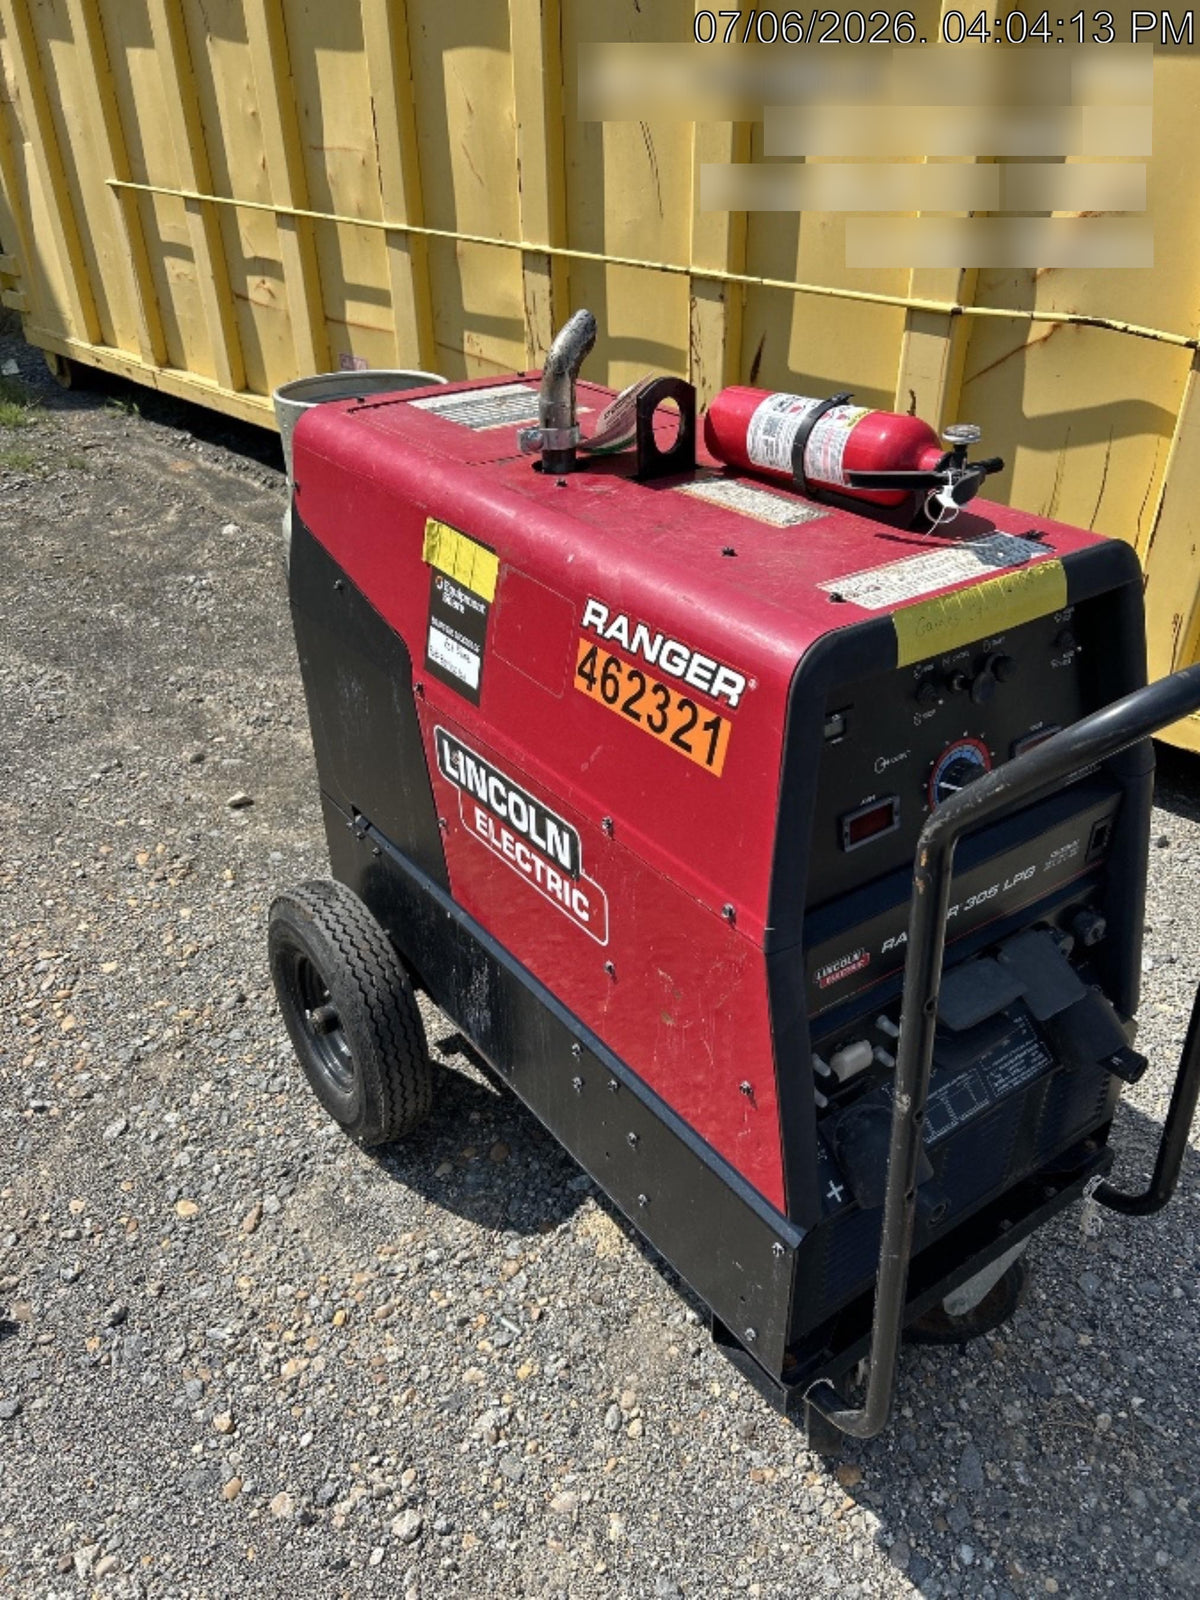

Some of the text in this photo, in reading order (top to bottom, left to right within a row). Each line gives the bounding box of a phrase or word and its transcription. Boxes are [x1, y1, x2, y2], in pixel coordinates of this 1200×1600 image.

[577, 645, 723, 767] 462321
[582, 599, 746, 707] RANGER
[442, 739, 572, 870] LINCOLN
[474, 806, 590, 922] ELECTRIC
[881, 903, 960, 954] RAR
[1003, 865, 1036, 891] LPG
